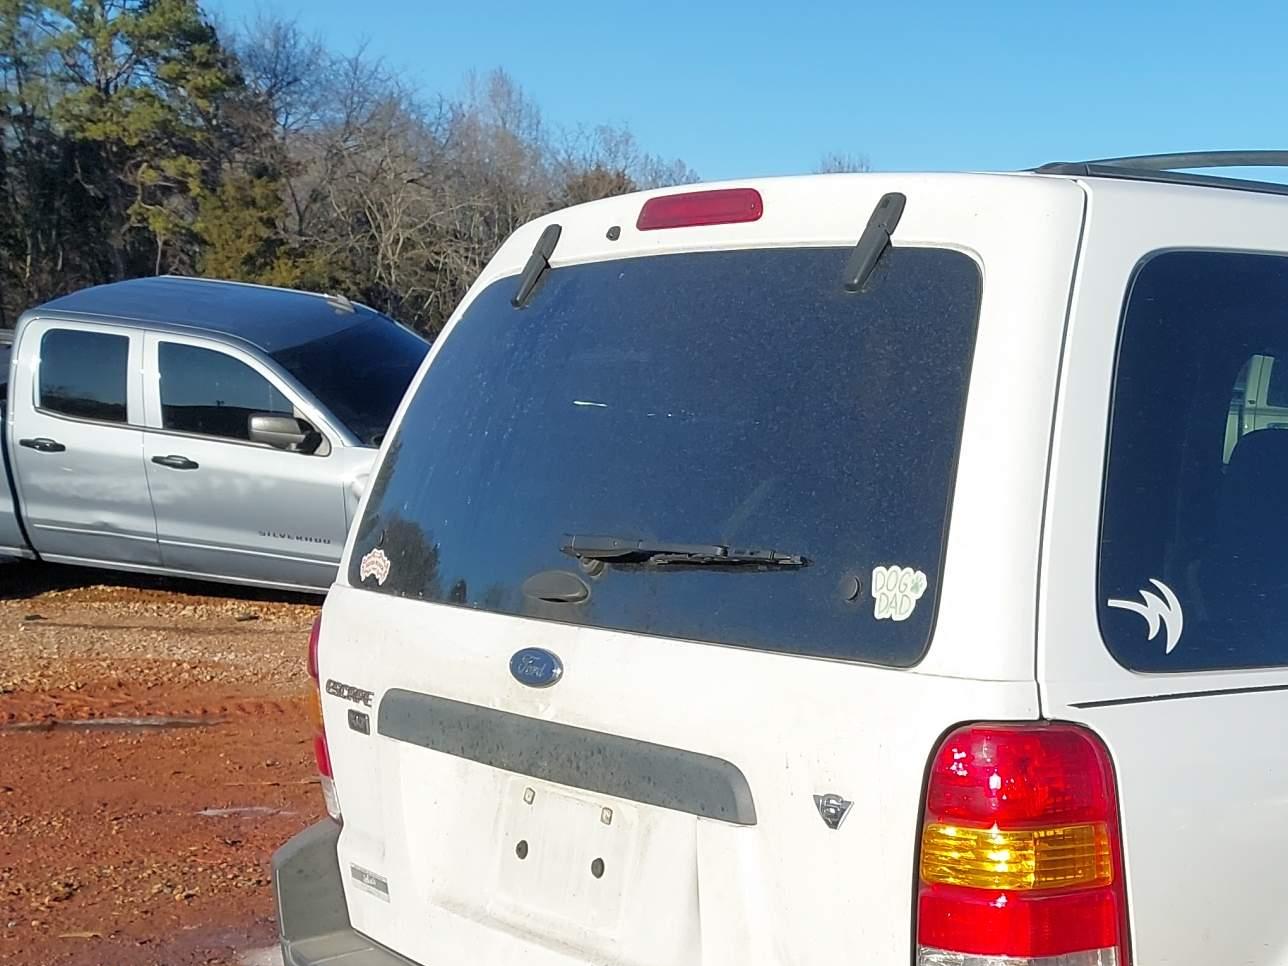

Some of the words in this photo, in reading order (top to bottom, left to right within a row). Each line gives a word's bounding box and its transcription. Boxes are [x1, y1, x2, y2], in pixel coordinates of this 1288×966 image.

[874, 569, 911, 594] DOG
[877, 592, 912, 616] DAD
[518, 655, 547, 678] Ford
[326, 679, 374, 707] ESCAPE
